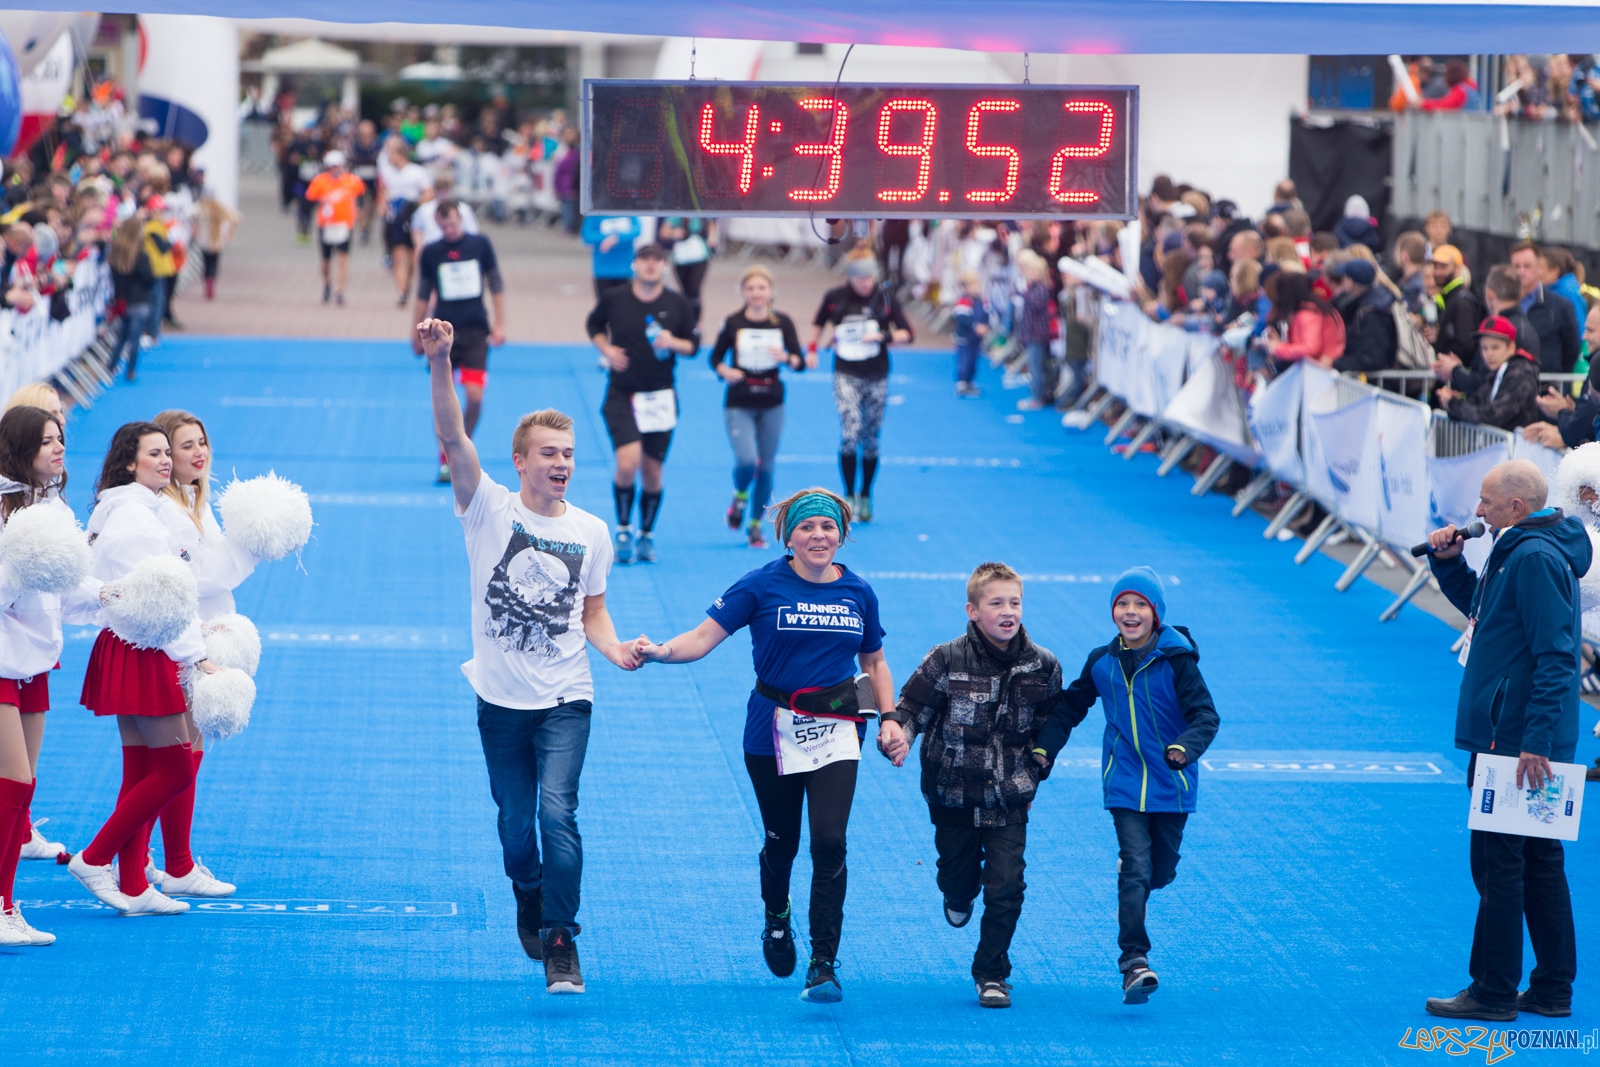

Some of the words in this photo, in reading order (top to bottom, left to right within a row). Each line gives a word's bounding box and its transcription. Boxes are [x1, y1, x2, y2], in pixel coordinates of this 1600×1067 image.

[699, 98, 1115, 203] 4:39.52
[537, 538, 547, 550] IS
[550, 541, 566, 554] MY
[566, 543, 587, 556] LOVE
[785, 613, 860, 629] WYZWANIE
[795, 722, 837, 745] 5577
